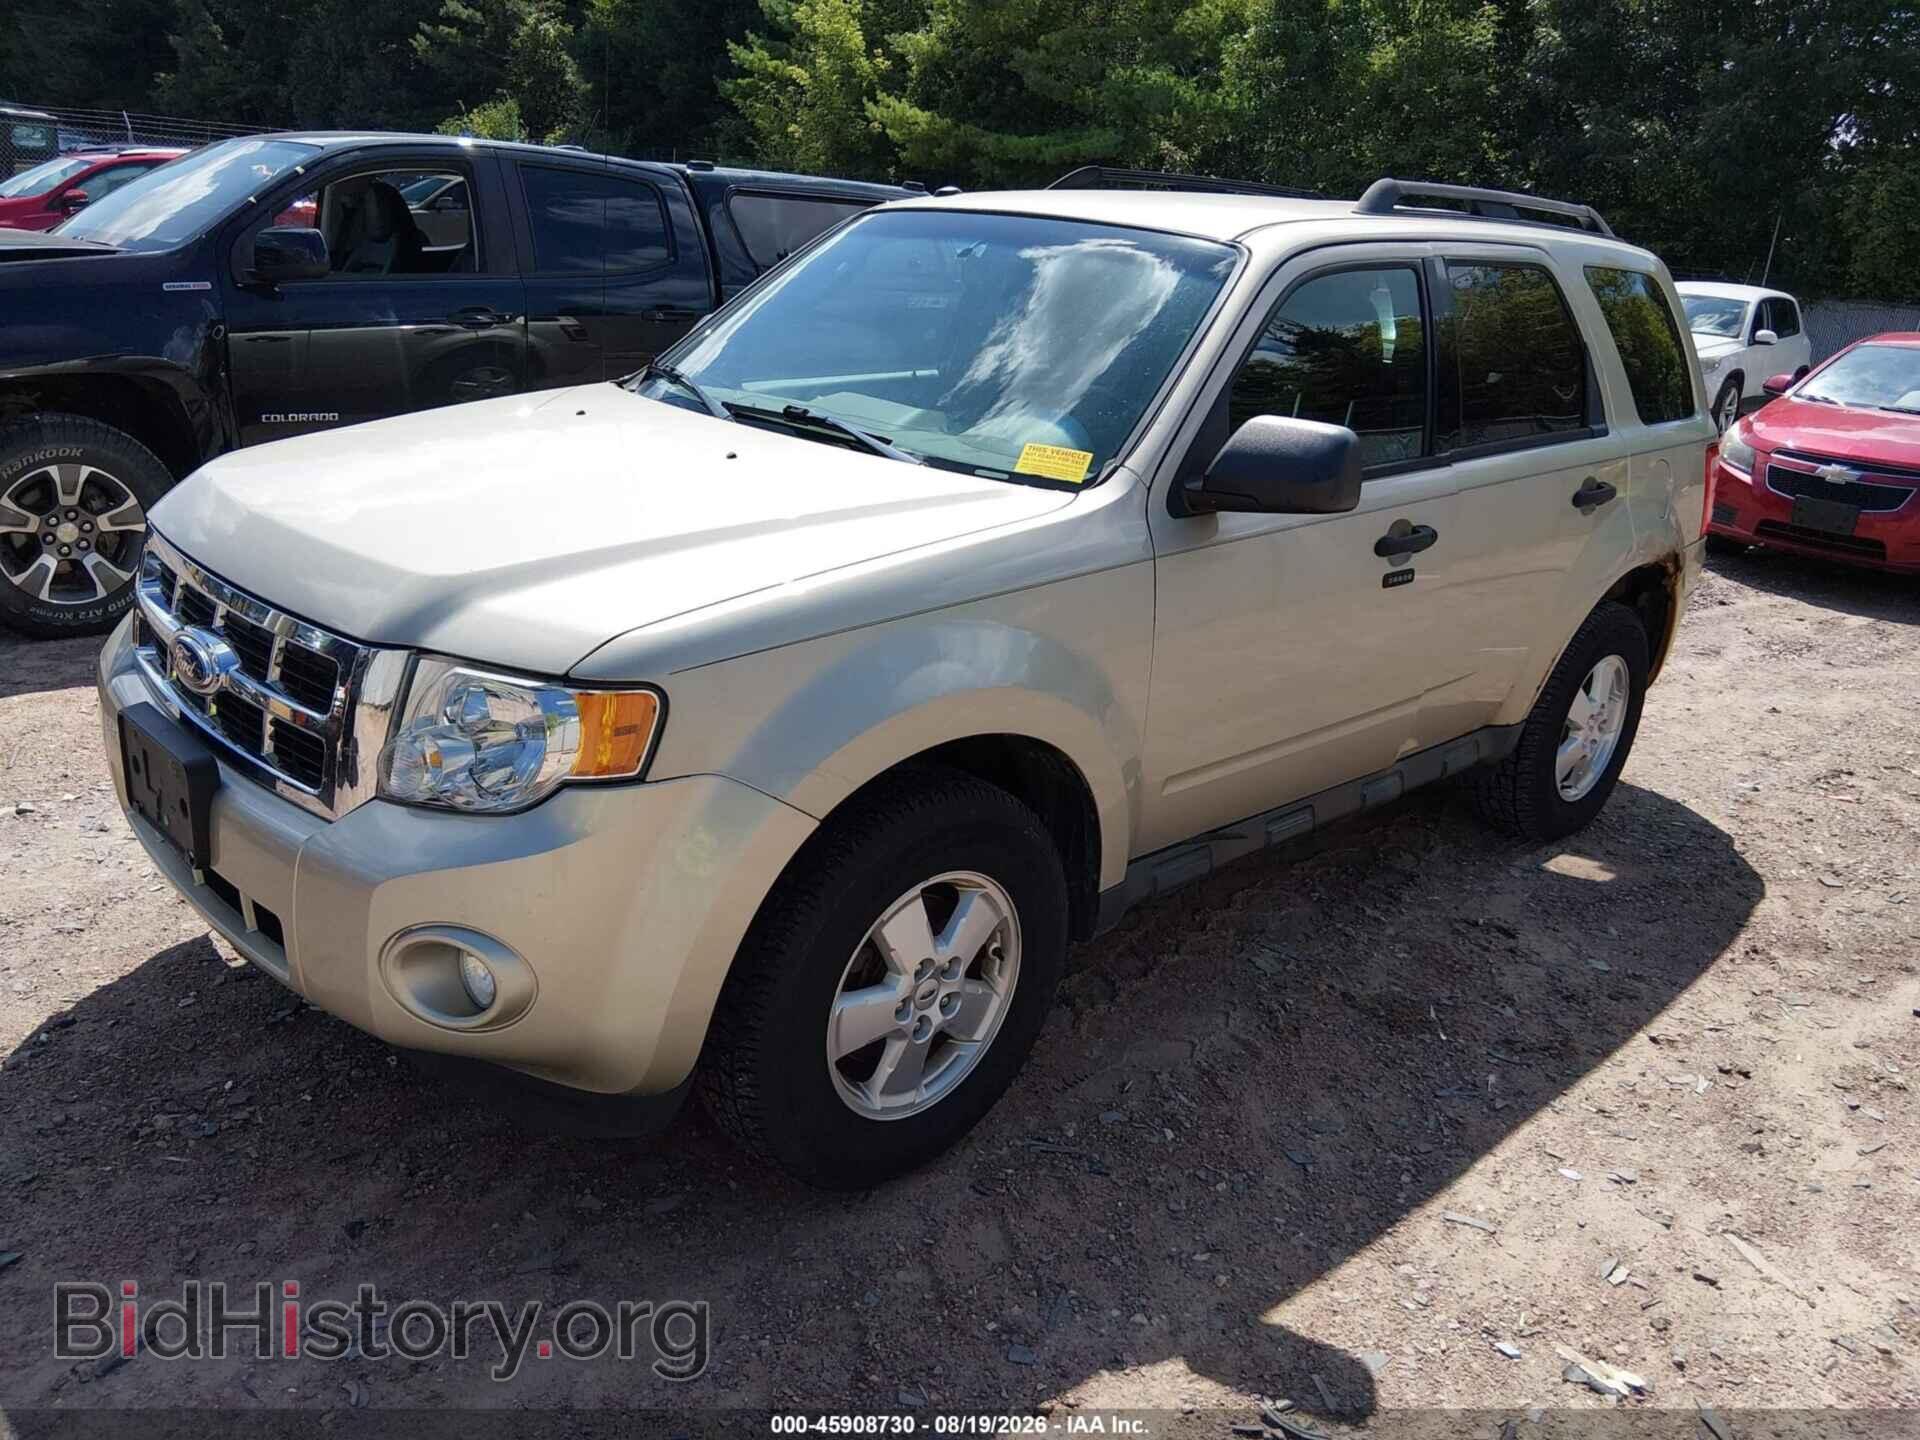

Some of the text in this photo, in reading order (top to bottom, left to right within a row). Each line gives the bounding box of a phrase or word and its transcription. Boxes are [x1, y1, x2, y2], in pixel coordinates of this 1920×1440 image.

[261, 412, 339, 423] COLORADO
[1028, 445, 1089, 460] THIS VEHICLE
[175, 643, 198, 678] Ford
